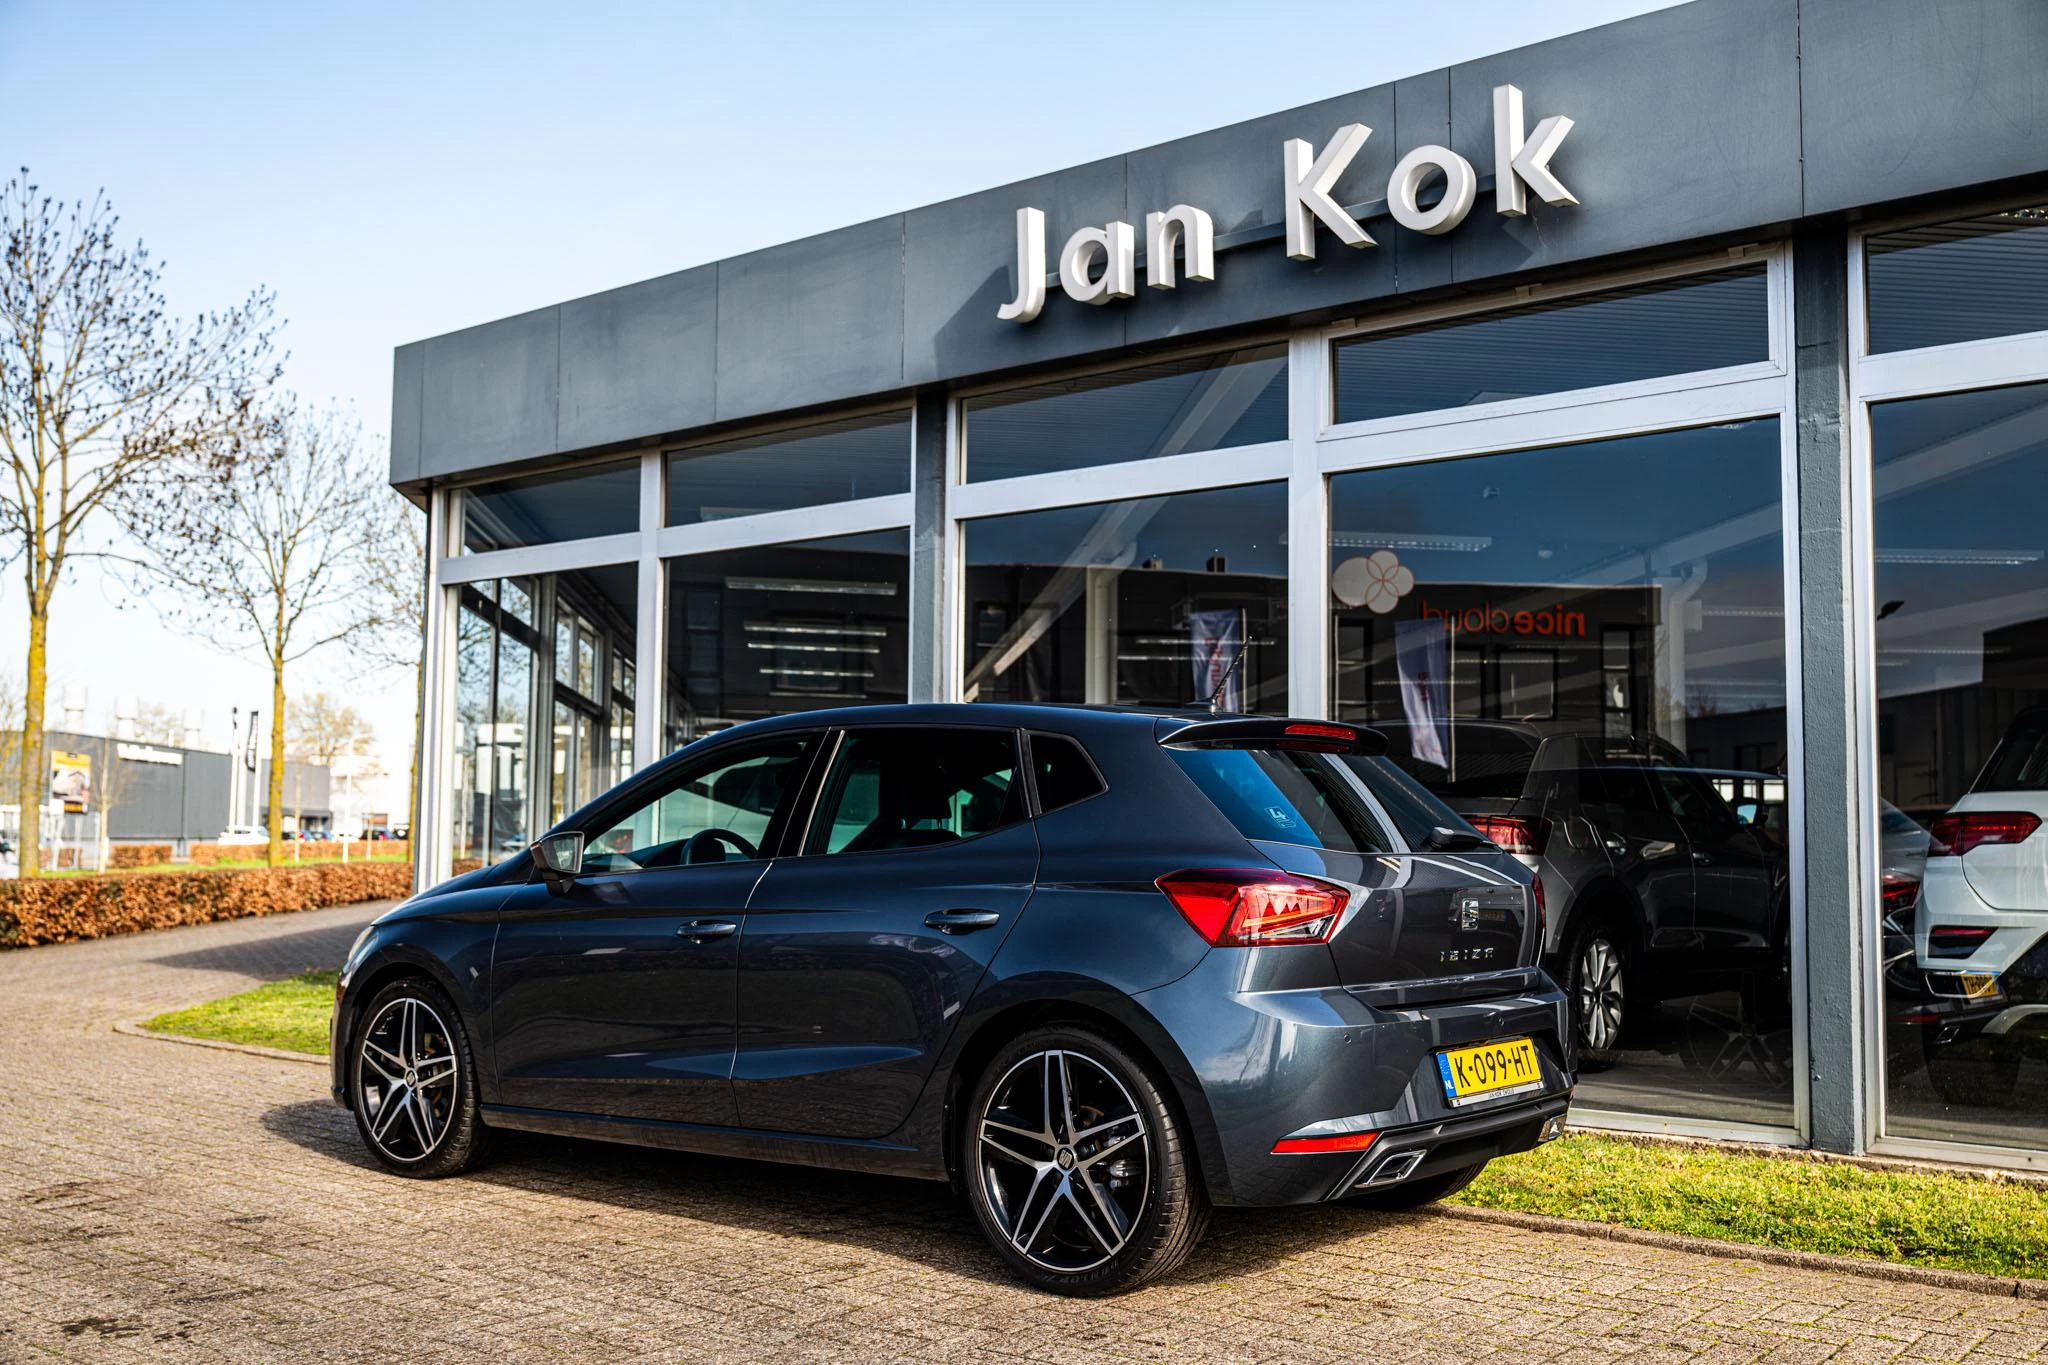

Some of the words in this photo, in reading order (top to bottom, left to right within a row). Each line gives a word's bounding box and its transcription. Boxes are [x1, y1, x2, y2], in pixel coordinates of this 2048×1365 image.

[997, 204, 1215, 323] Jan
[1283, 84, 1580, 261] Kok
[1440, 947, 1494, 963] IBIZA
[1454, 1045, 1532, 1088] K-099-HT
[1445, 1080, 1455, 1090] NL
